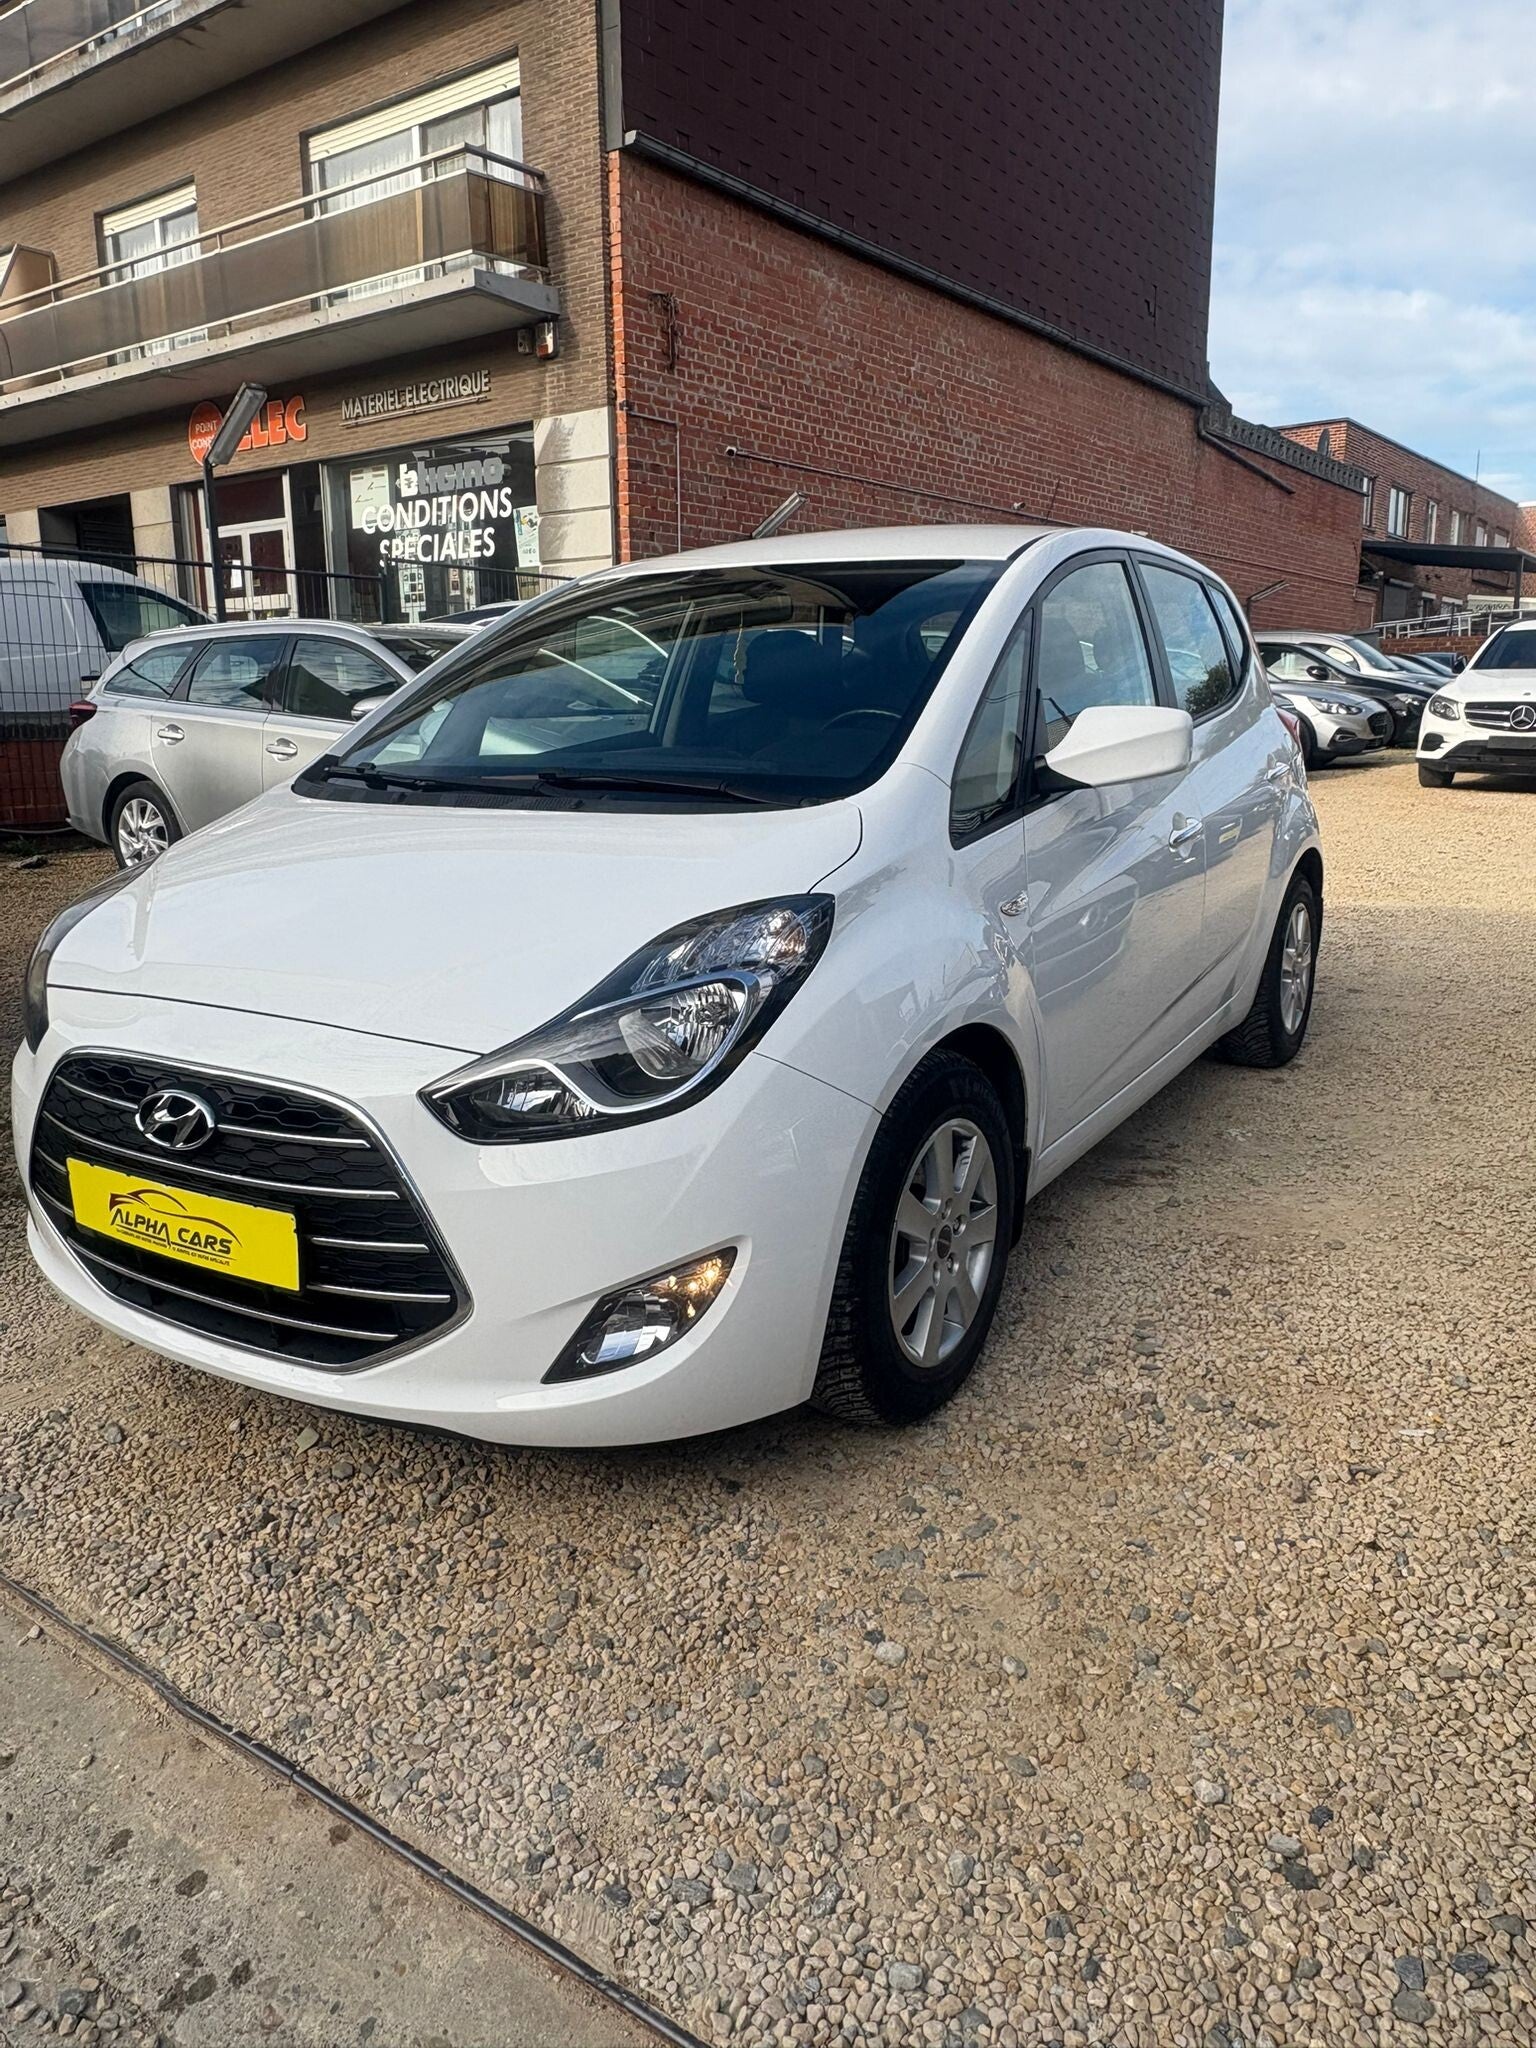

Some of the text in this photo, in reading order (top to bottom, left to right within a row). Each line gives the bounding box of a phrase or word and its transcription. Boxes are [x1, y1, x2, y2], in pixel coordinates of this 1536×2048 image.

[341, 369, 491, 420] MATERIEL ELECTRIQUE
[195, 420, 218, 435] POINT
[361, 486, 513, 535] CONDITIONS
[379, 527, 496, 567] SPECIALES
[110, 1208, 171, 1247] ALPHA
[177, 1227, 233, 1255] CARS
